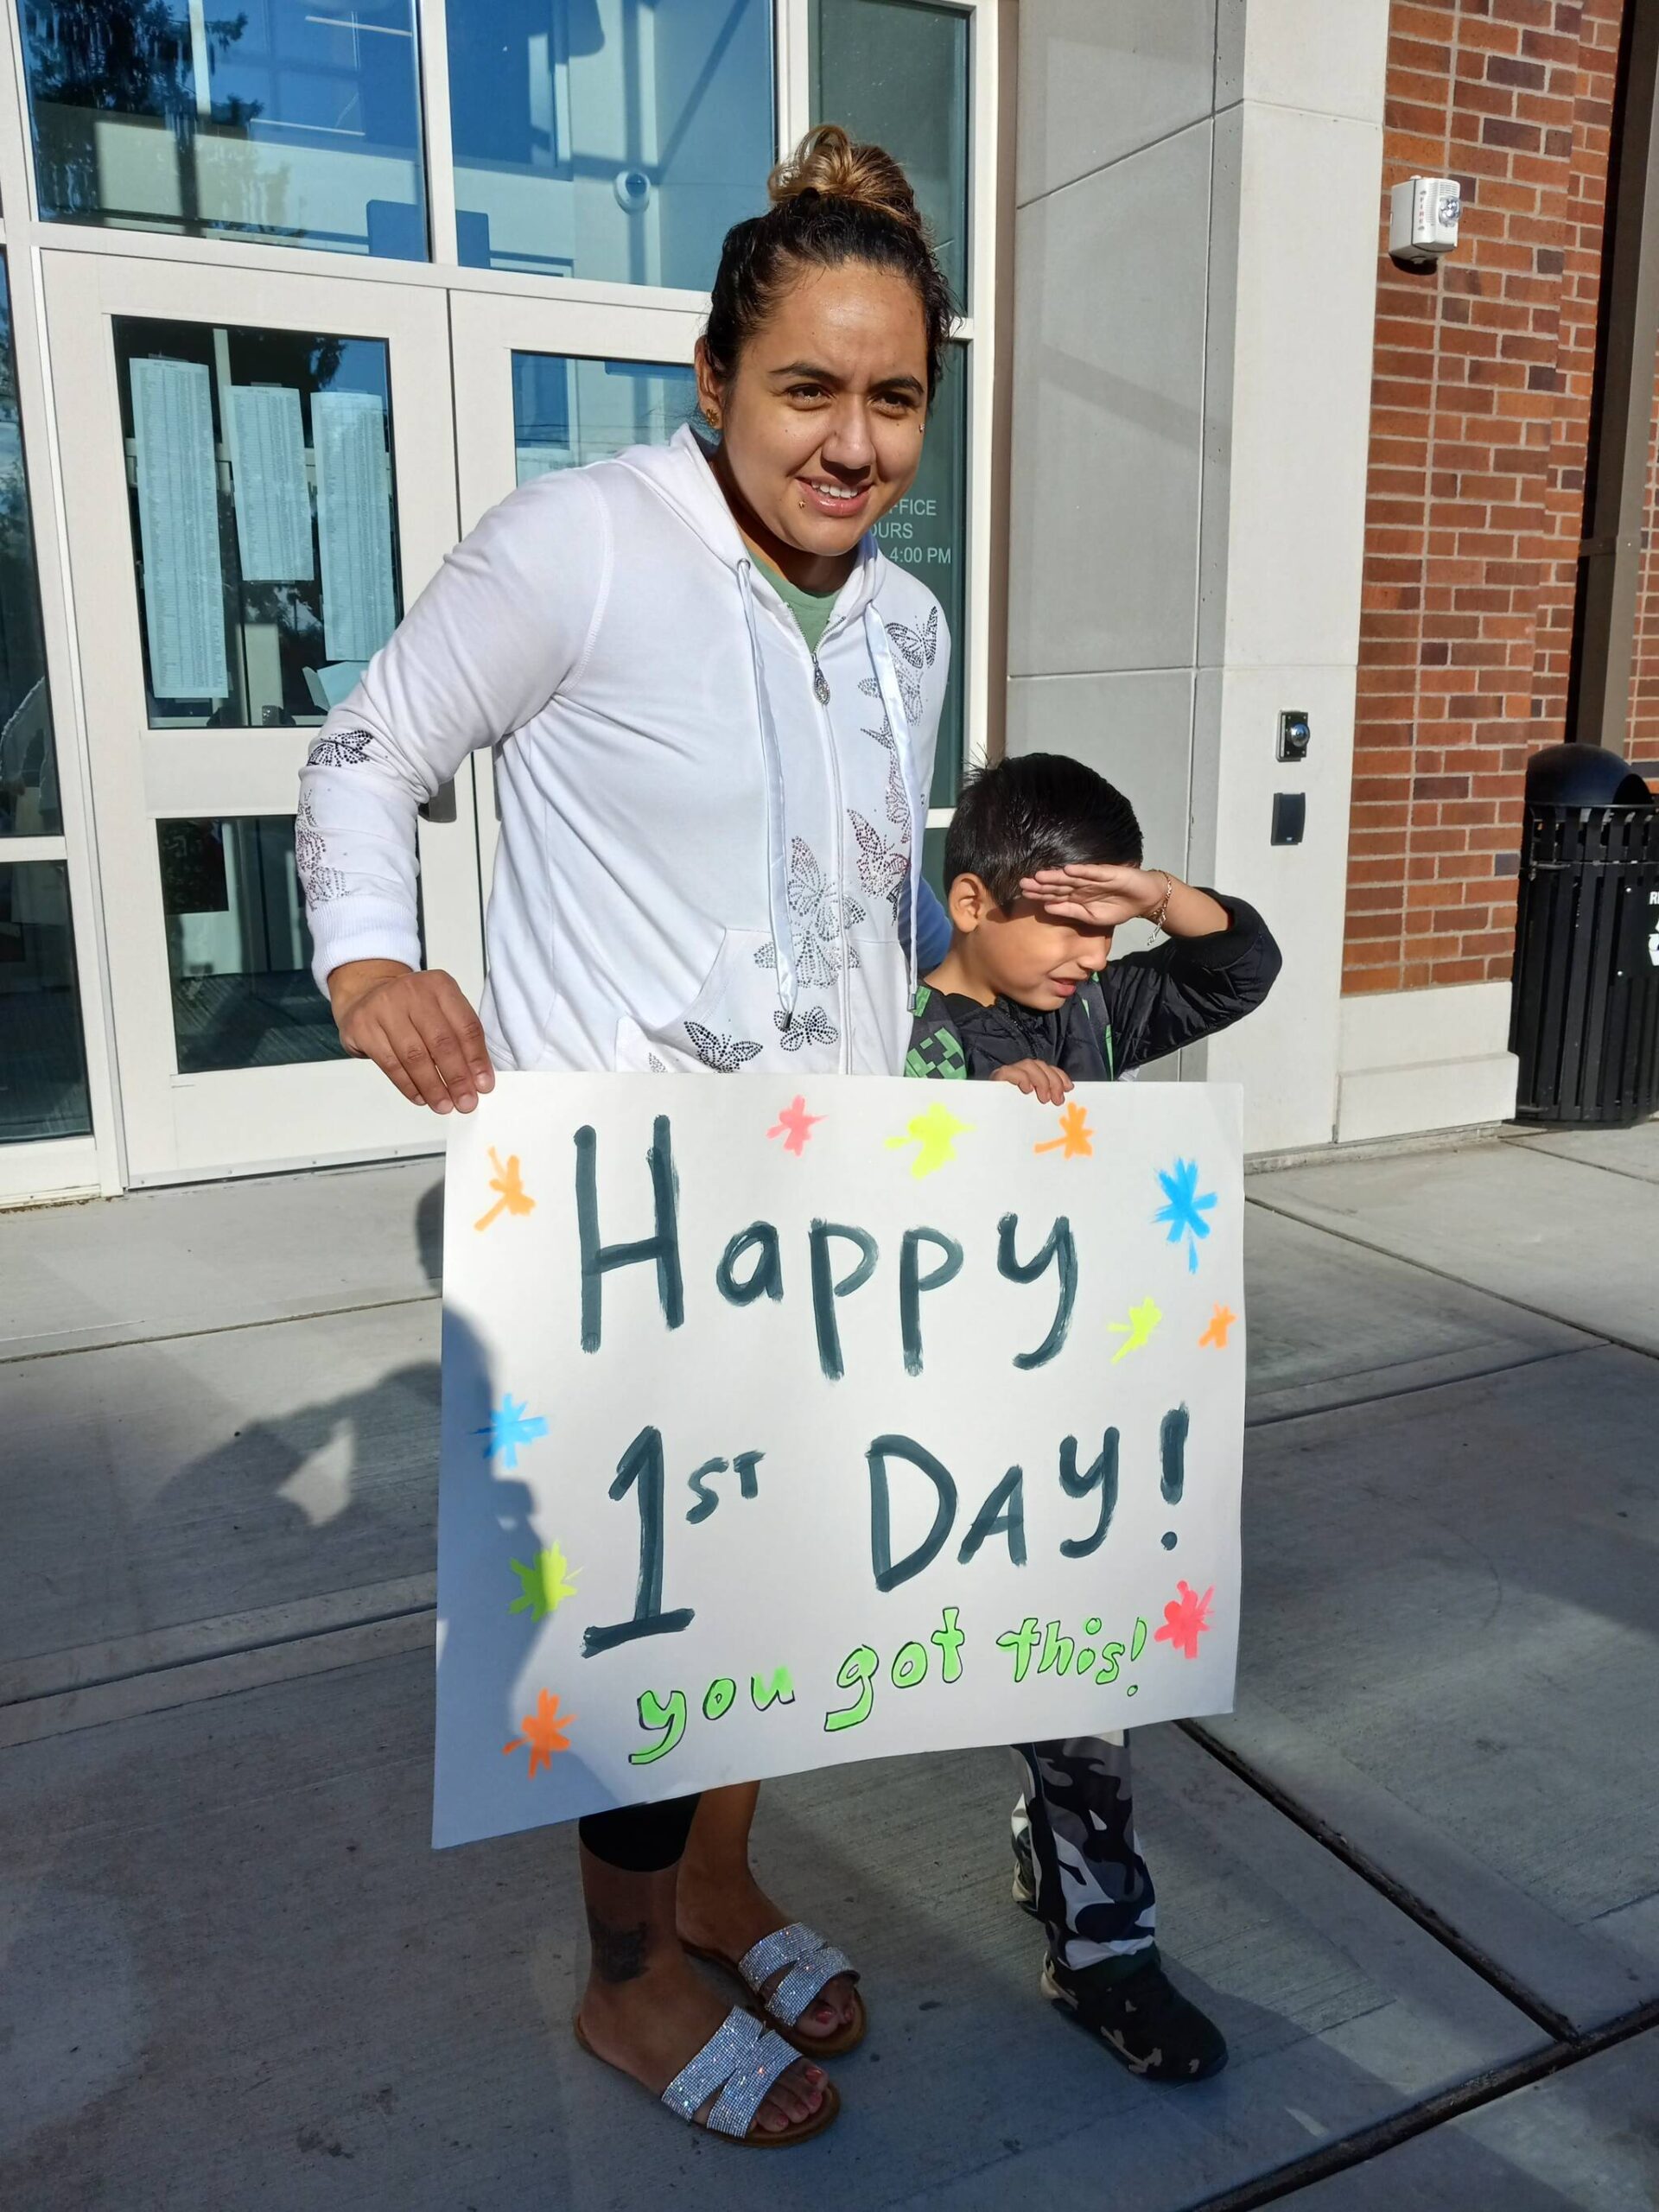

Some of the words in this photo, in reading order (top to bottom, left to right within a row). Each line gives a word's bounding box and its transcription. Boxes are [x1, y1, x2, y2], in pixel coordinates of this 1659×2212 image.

[889, 546, 922, 563] 4:00
[927, 548, 950, 563] PM
[573, 1114, 1078, 1380] Happy
[581, 1425, 766, 1659] 1ST
[866, 1402, 1189, 1592] DAY!
[628, 1664, 795, 1765] you
[824, 1607, 965, 1732] got
[996, 1617, 1147, 1697] this!
